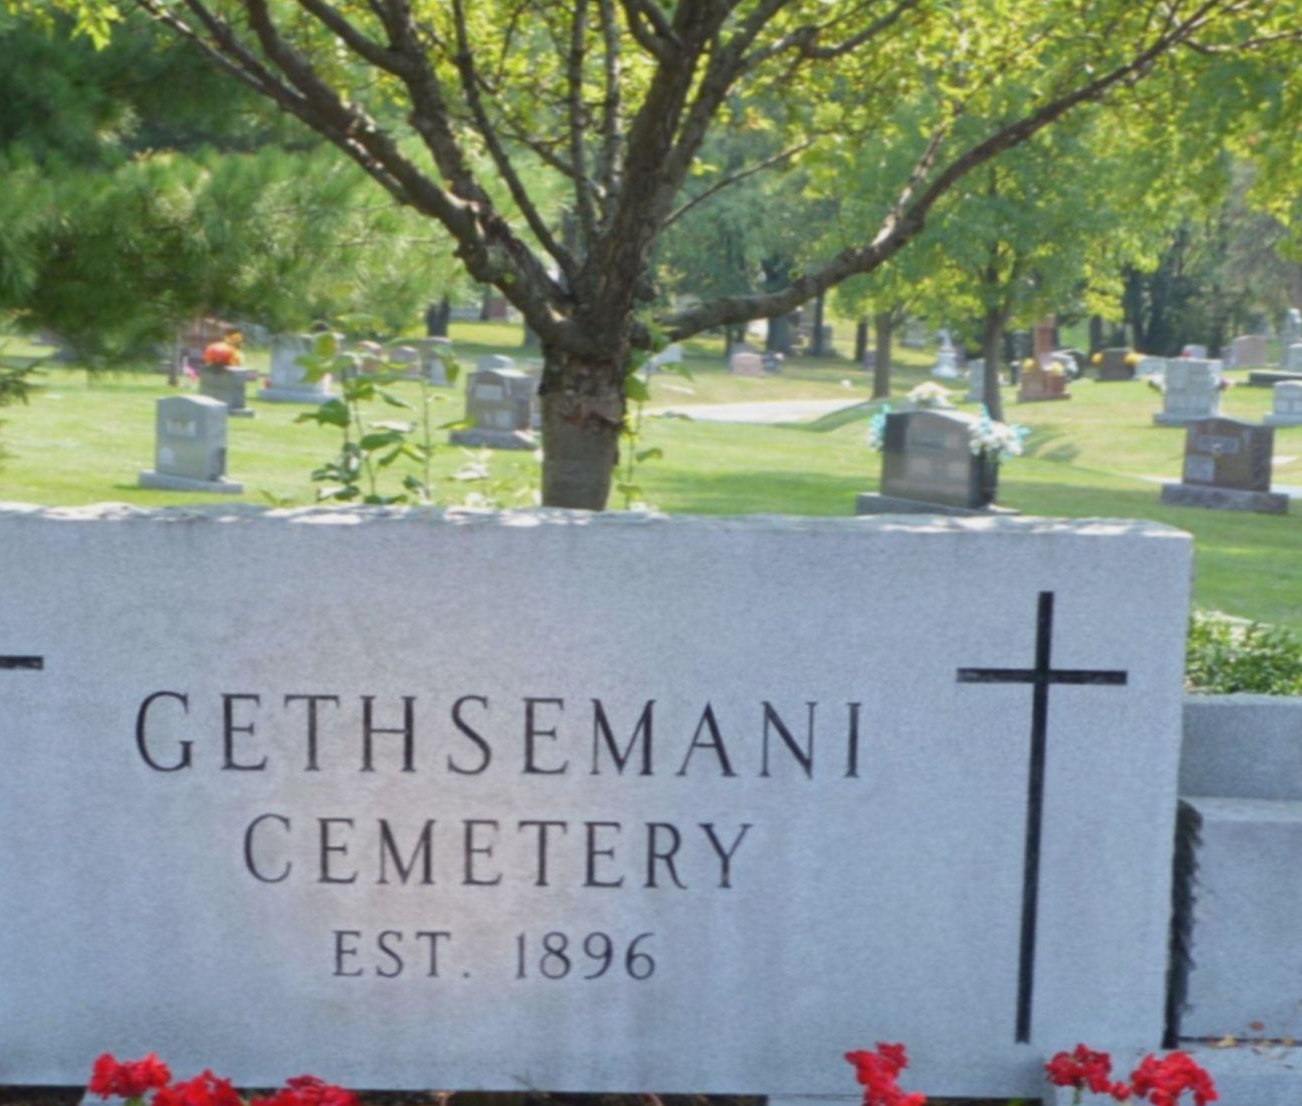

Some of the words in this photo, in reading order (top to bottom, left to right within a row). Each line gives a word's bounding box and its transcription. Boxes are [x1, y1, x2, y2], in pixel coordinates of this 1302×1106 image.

[134, 690, 863, 779] GETHSEMANI
[243, 813, 754, 890] CEMETERY
[332, 930, 470, 979] EST.
[515, 931, 657, 981] 1896
